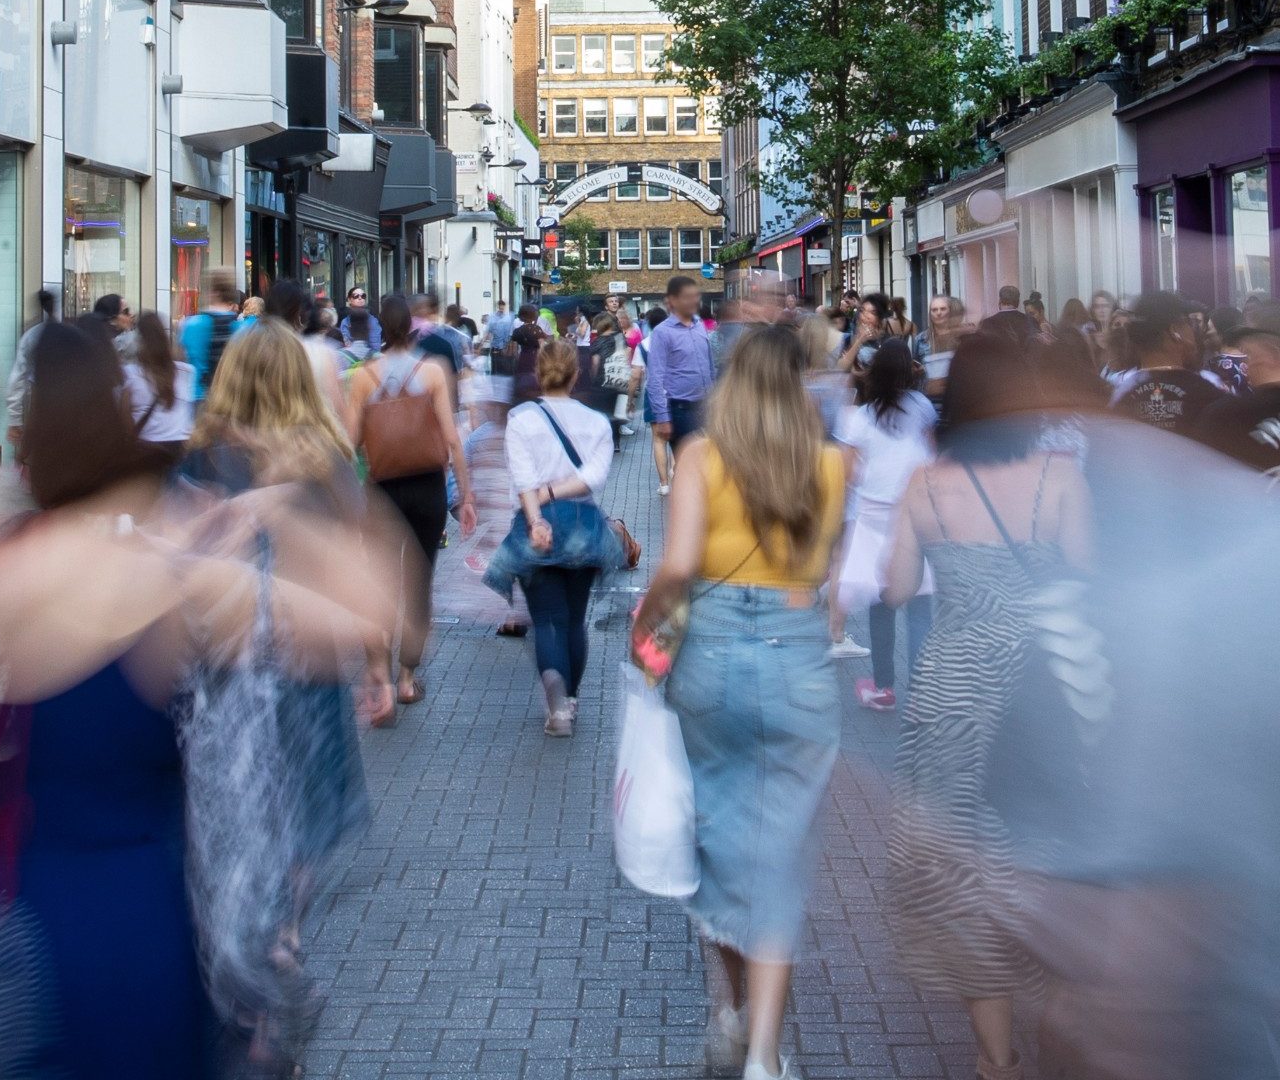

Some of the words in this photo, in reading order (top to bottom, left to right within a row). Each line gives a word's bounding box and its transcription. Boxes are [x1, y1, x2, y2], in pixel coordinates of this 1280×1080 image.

[906, 118, 936, 131] VANS
[607, 171, 621, 181] TO
[646, 168, 688, 188] CARNABY
[687, 184, 717, 207] STREET
[1135, 382, 1155, 395] WAS
[1158, 382, 1186, 398] THERE
